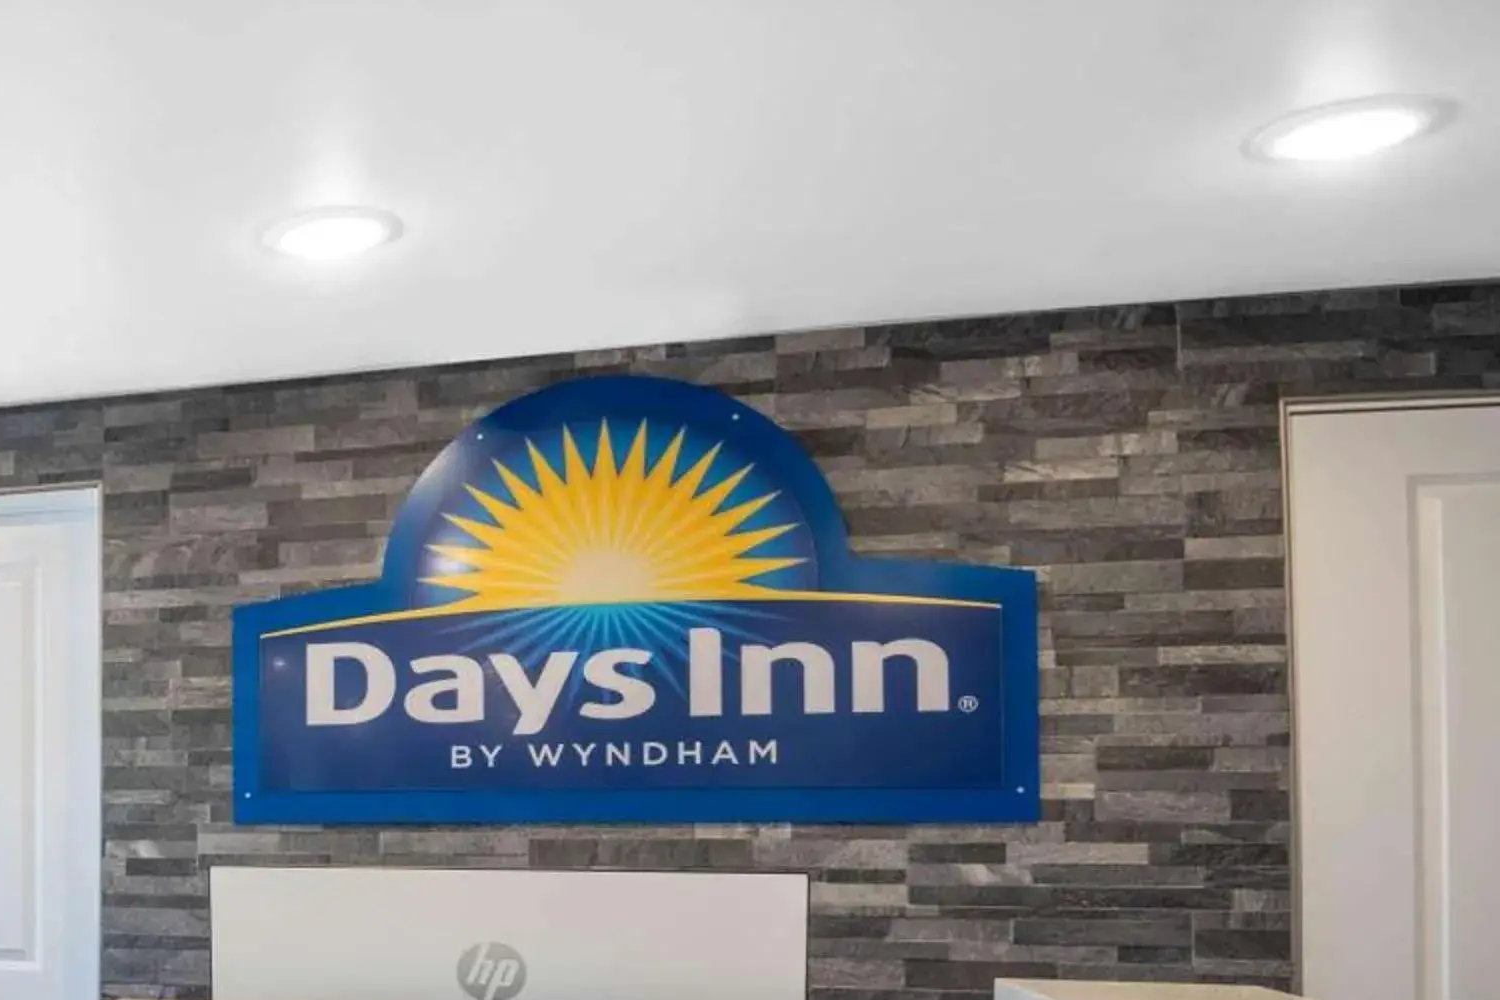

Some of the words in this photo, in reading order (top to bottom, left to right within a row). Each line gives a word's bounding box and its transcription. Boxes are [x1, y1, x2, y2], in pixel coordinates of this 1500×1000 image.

[305, 641, 657, 736] Days
[688, 627, 950, 717] Inn
[450, 744, 502, 769] BY
[528, 739, 778, 768] WYNDHAM
